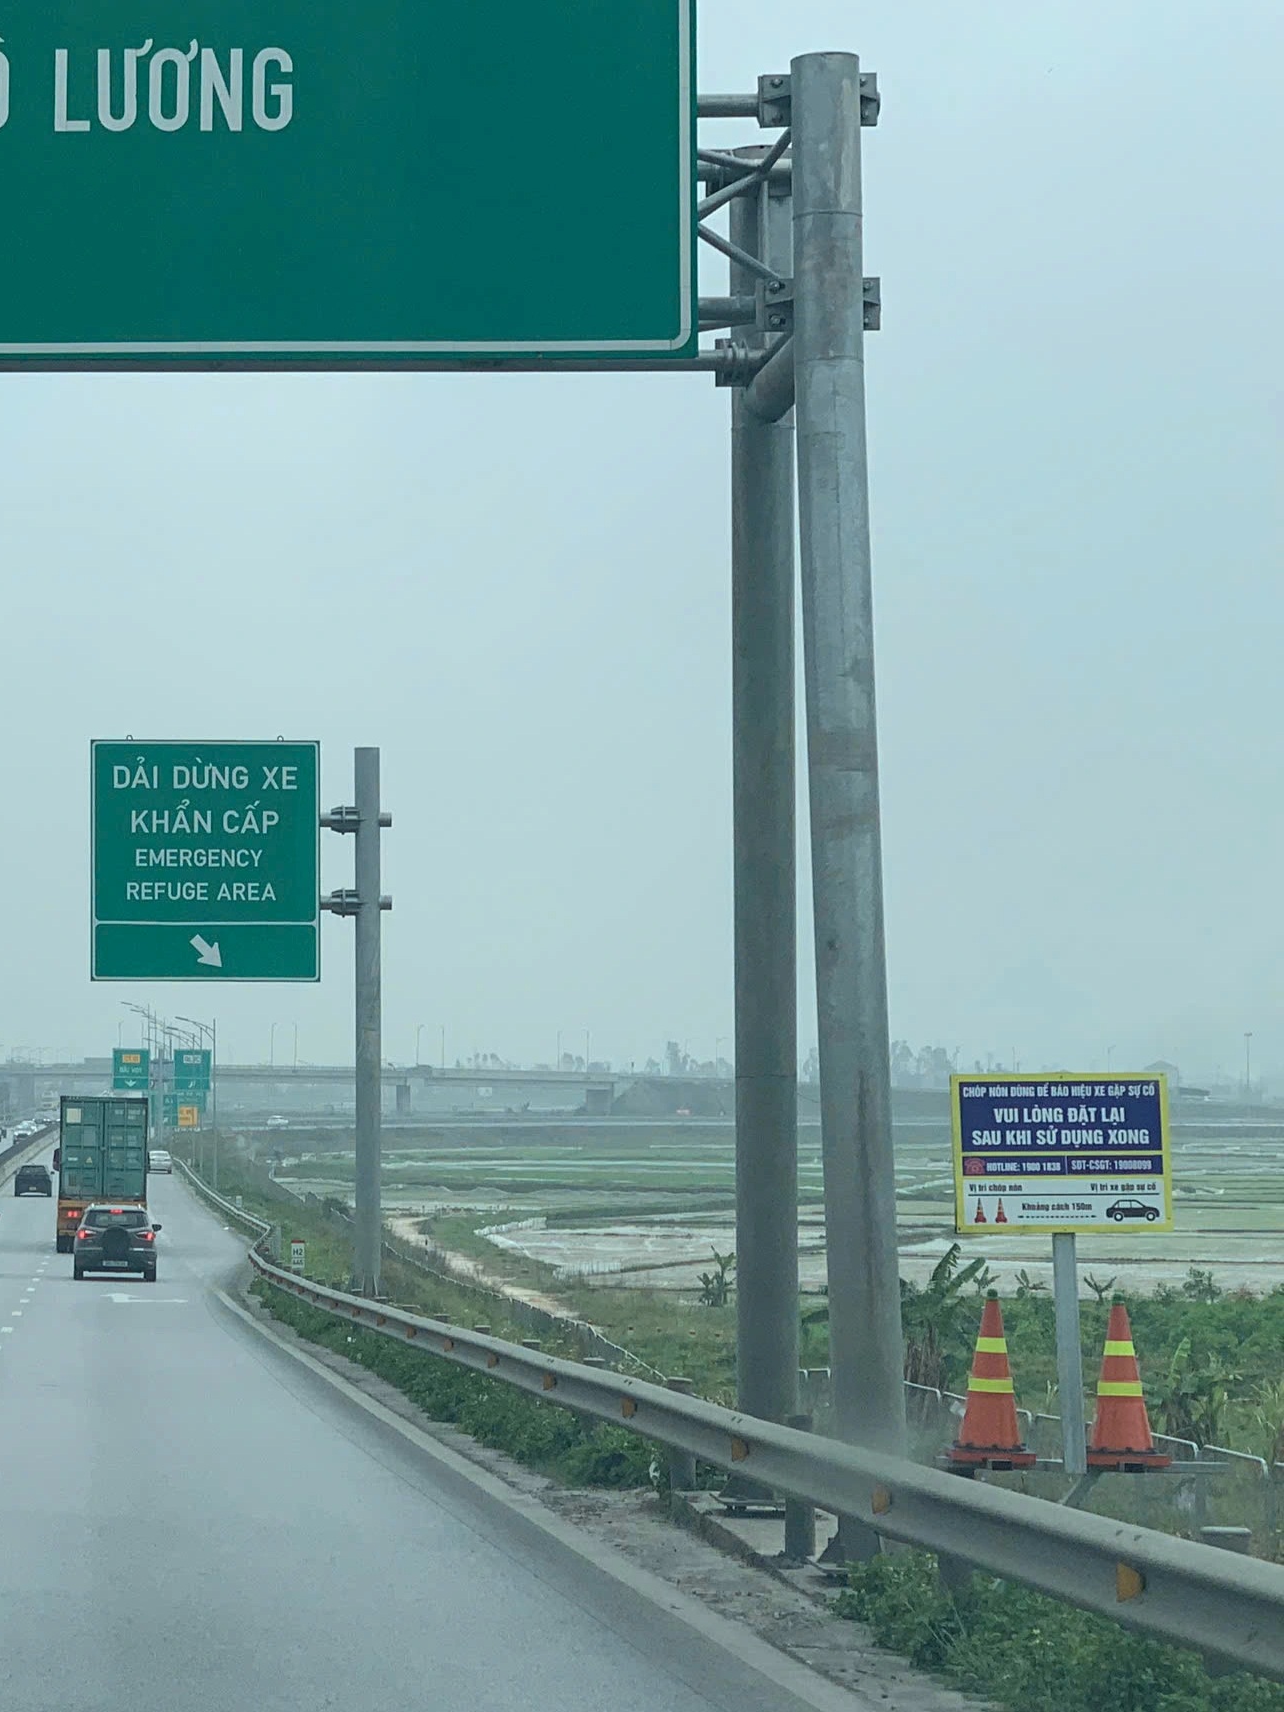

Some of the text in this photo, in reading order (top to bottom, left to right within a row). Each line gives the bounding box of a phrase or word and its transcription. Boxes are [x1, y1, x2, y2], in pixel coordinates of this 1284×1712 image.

[54, 38, 293, 132] LƯƠNG
[112, 756, 298, 790] DẢI DỪNG XE
[131, 799, 280, 834] KHẨN CẤP
[135, 848, 263, 867] EMERGENCY
[126, 882, 277, 901] REFUGE AREA
[1051, 1084, 1069, 1096] BÁO
[1071, 1084, 1092, 1099] HIỆU
[1094, 1085, 1106, 1096] XE
[1108, 1084, 1126, 1099] GẶP
[1128, 1084, 1141, 1098] SỰ
[1142, 1082, 1155, 1096] CỐ
[993, 1104, 1125, 1126] VUI LÒNG ĐẶT LẠI
[972, 1126, 1150, 1148] SAU KHI SỬ DỤNG XONG
[986, 1162, 1020, 1172] HOTLINE:
[1072, 1202, 1093, 1211] 150m
